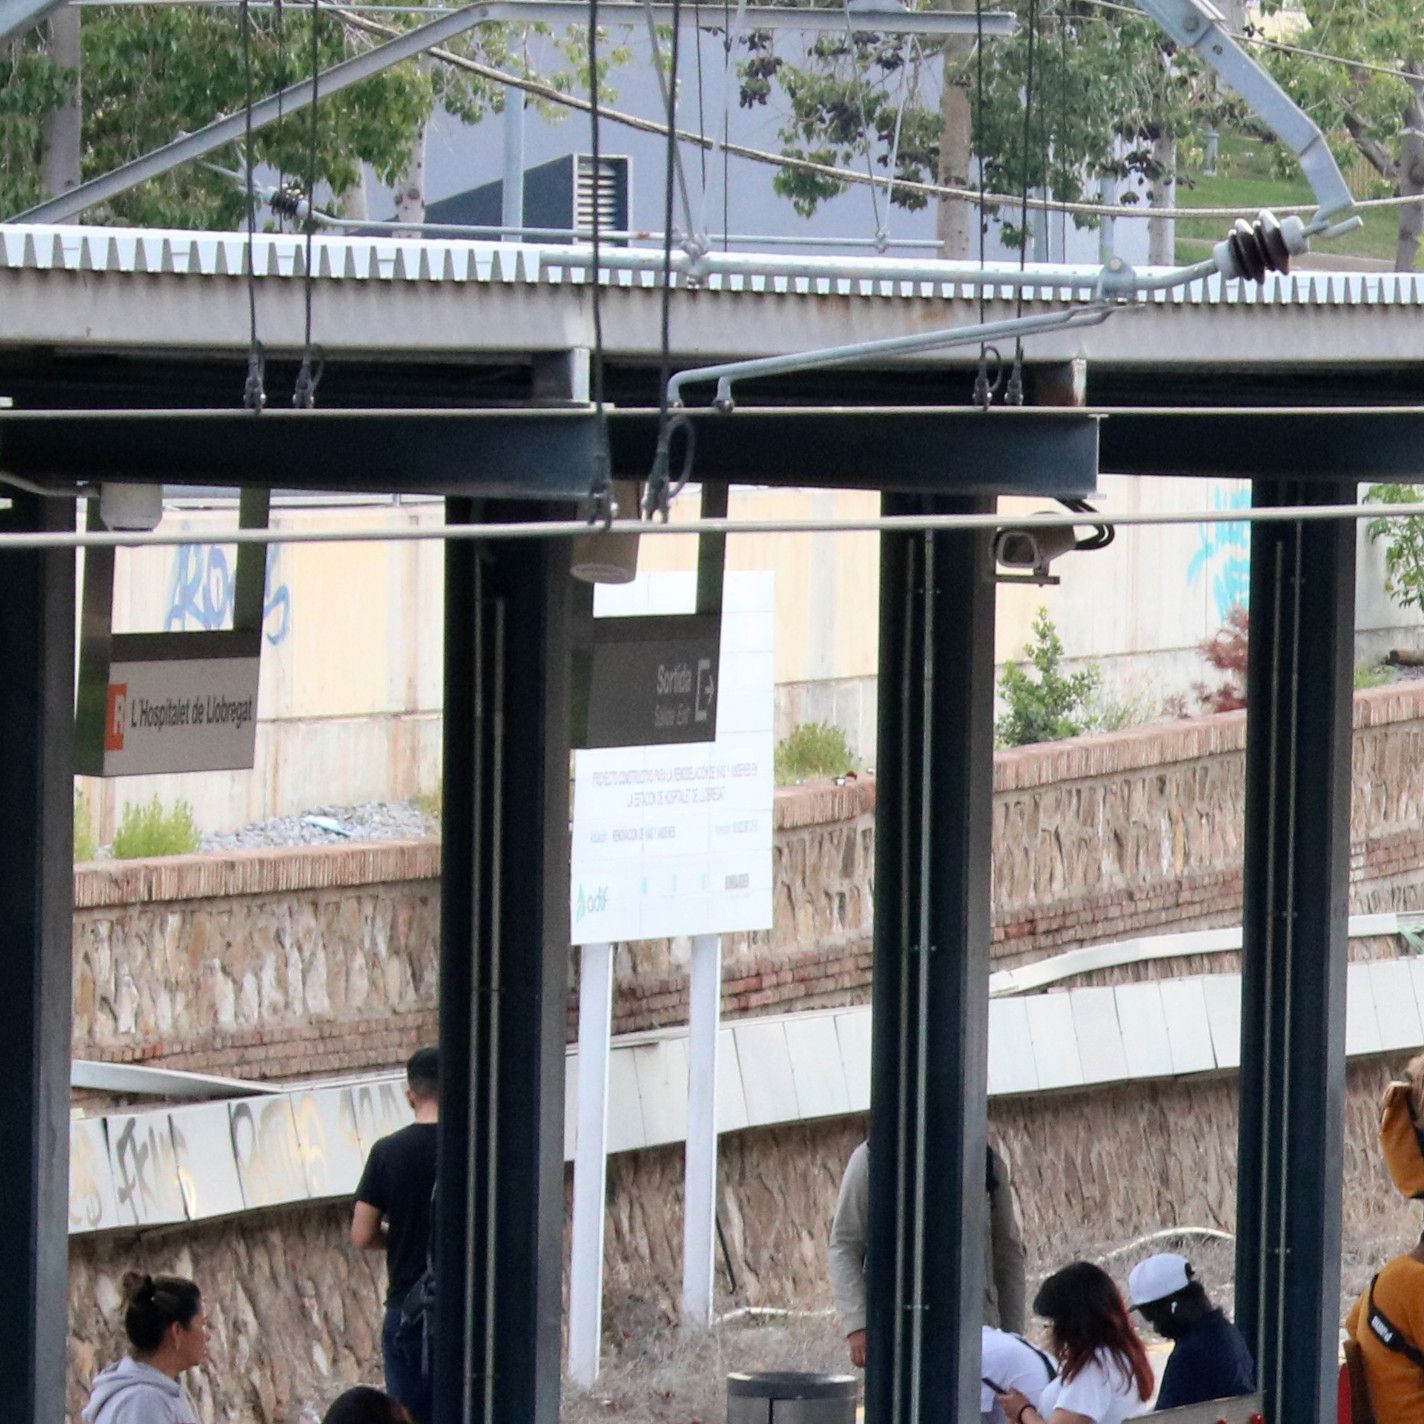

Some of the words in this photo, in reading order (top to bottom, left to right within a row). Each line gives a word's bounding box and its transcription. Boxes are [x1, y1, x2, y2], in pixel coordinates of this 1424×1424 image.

[131, 696, 190, 732] L'Hospitalet
[191, 697, 204, 725] de
[206, 694, 252, 729] Llobregat
